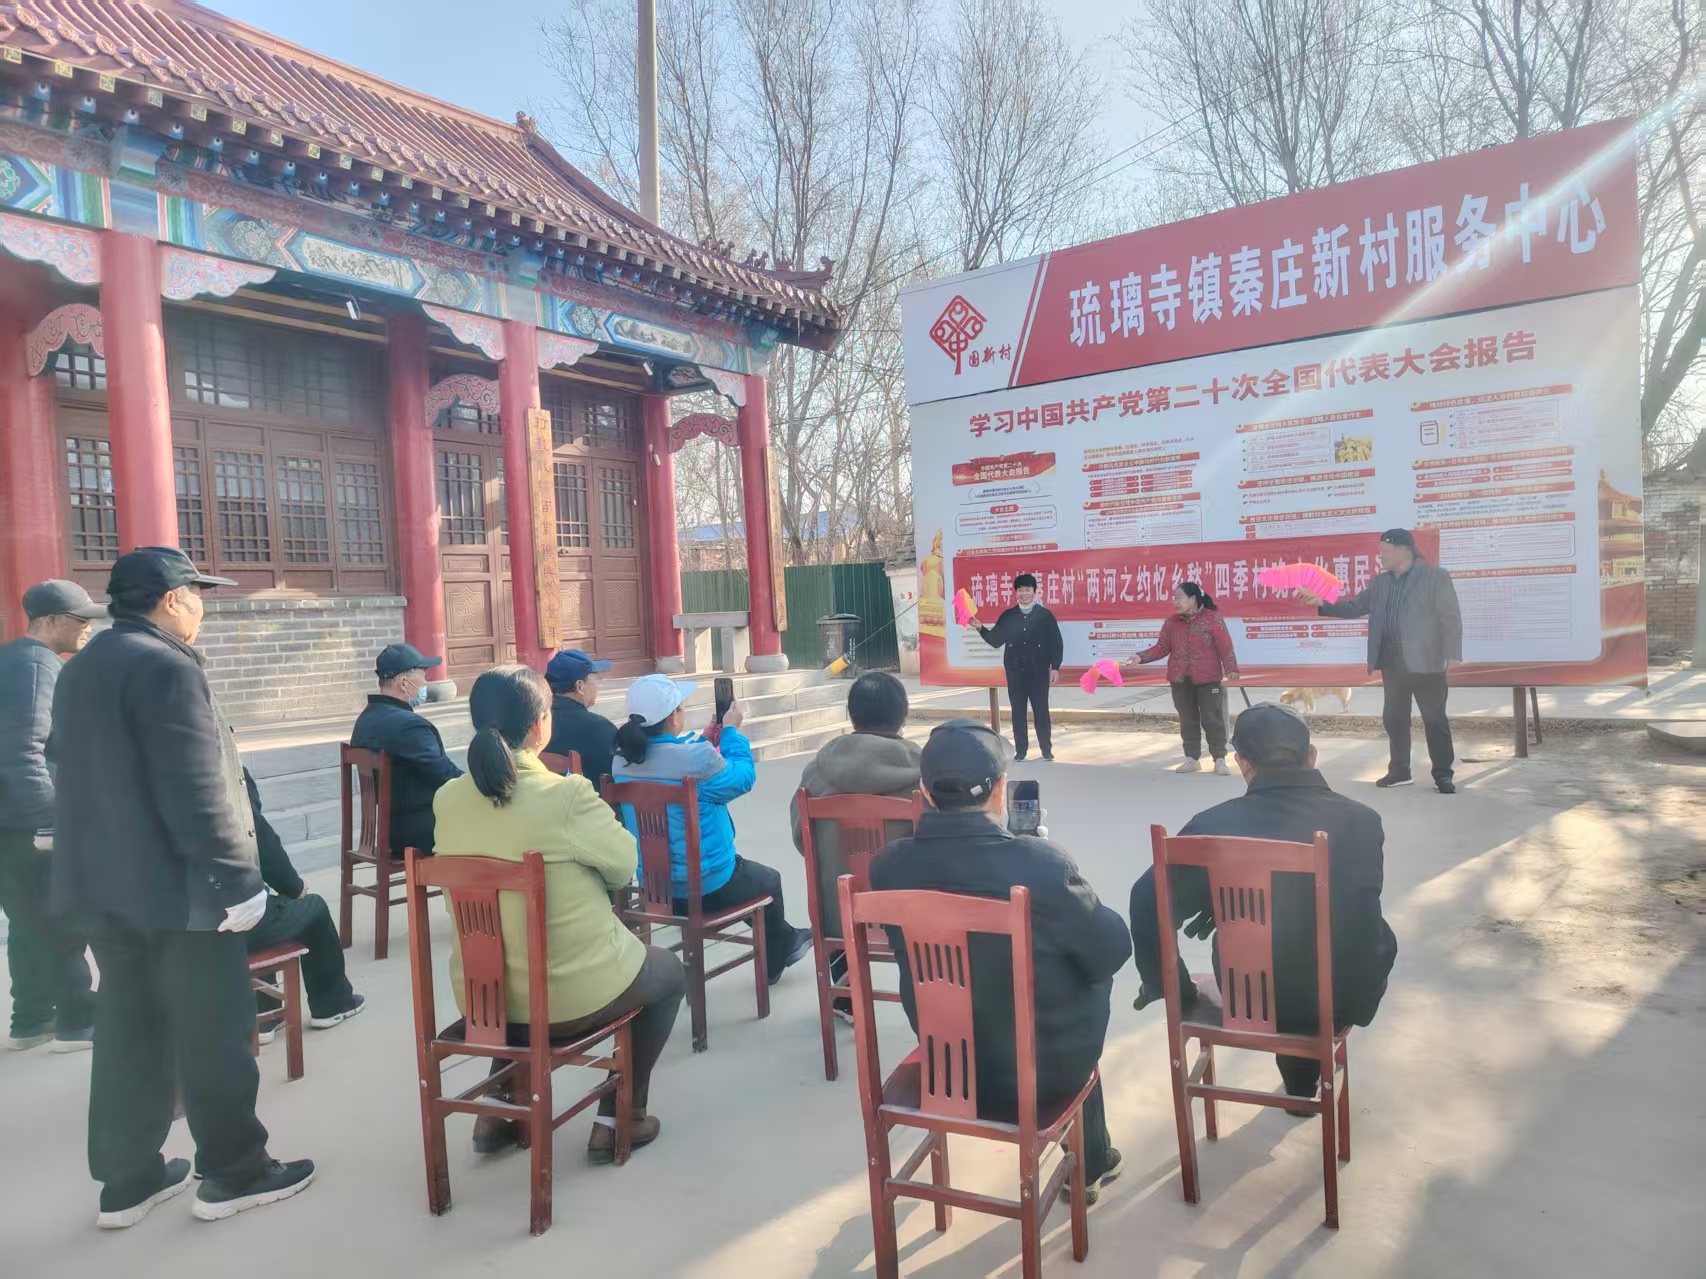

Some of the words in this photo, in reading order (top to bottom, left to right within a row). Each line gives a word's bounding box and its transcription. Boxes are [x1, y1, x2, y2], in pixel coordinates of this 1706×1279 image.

[1068, 181, 1606, 348] 琉璃寺镇秦庄新村服务中心
[969, 331, 1537, 437] 学习中国共产党第二十次全国代表大会报告
